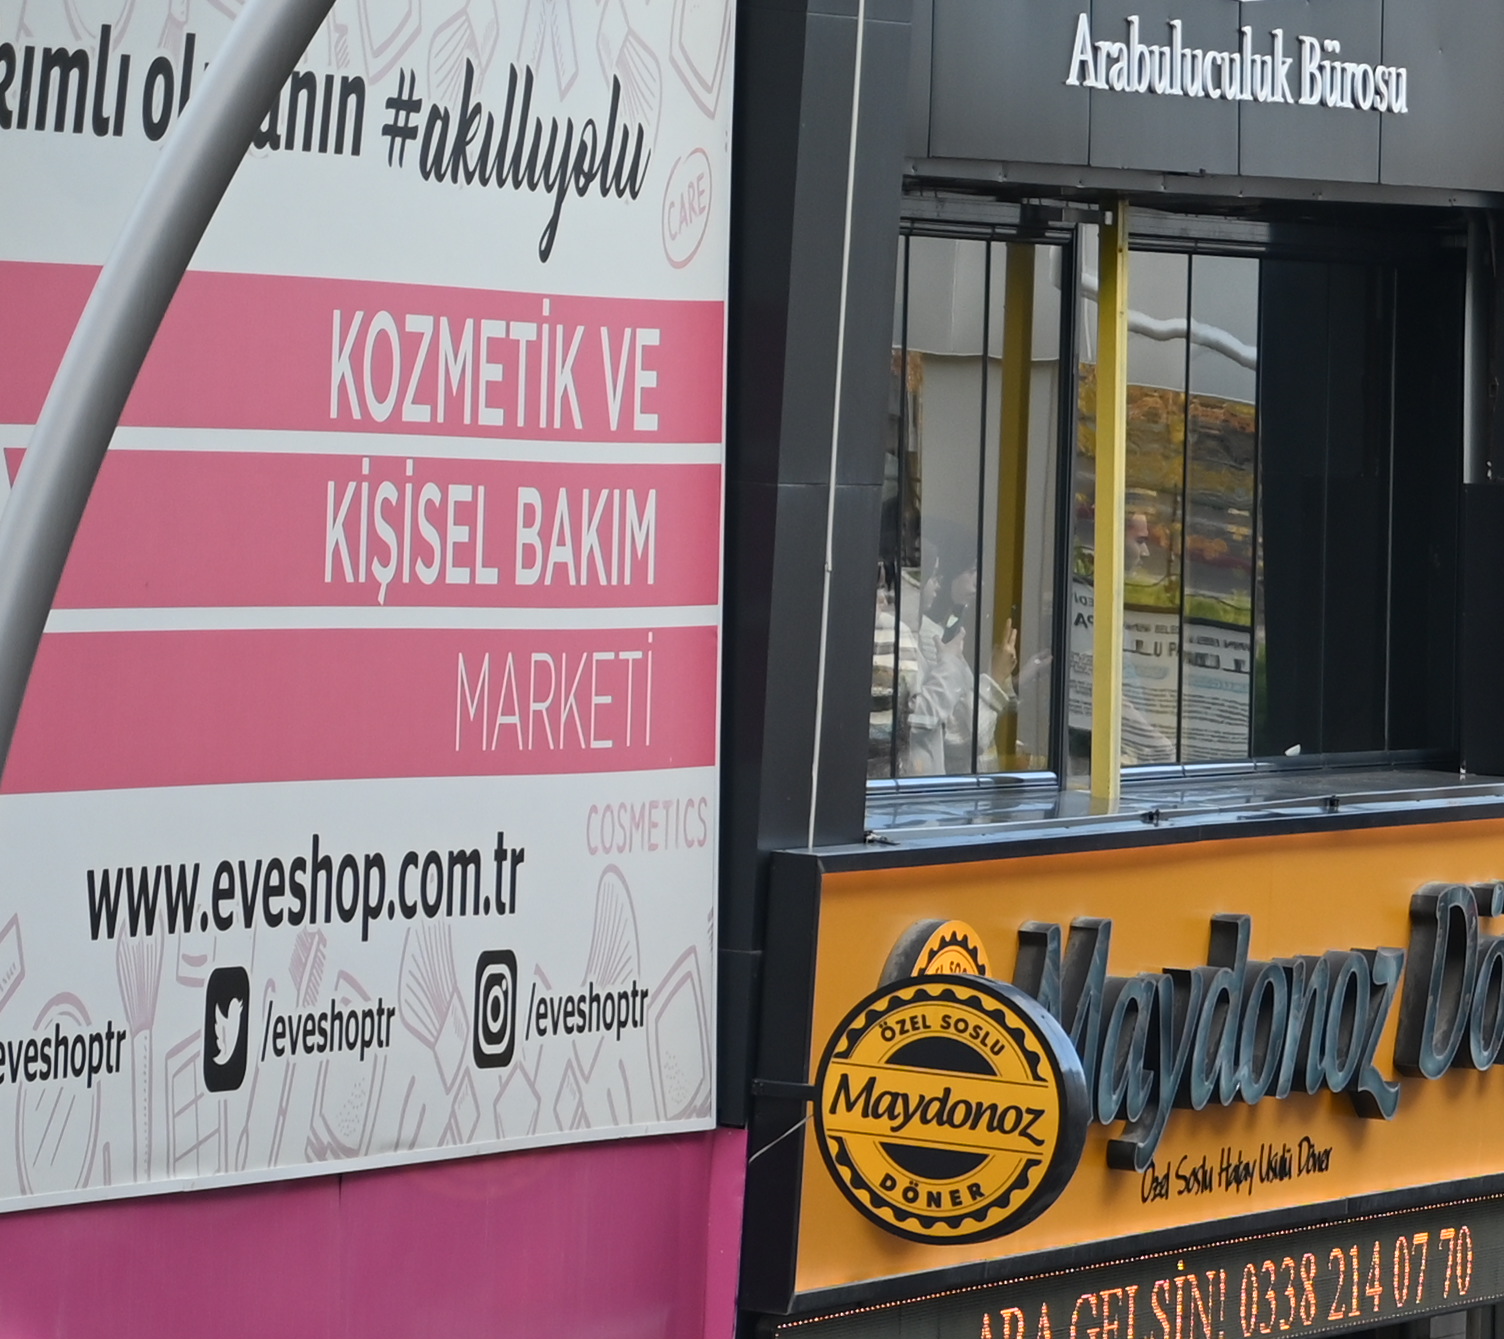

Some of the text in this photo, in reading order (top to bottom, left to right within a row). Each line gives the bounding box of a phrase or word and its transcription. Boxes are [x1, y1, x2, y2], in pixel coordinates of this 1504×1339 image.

[1065, 12, 1409, 114] Arabuluculuk Bürosu
[666, 174, 708, 243] CARE
[330, 298, 661, 433] KOZMETİK VE
[324, 457, 657, 606] KİŞİSEL BAKIM
[455, 632, 655, 752] MARKETİ
[586, 797, 709, 855] COSMETICS
[86, 830, 526, 942] www.eveshop.com.tr
[879, 1014, 1006, 1057] ÖZEL SOSLU
[1014, 914, 1403, 1171] Maydonoz
[829, 1073, 1045, 1147] Maydonoz
[878, 1172, 986, 1209] DÖNER
[1177, 1154, 1213, 1196] Soslu
[1240, 1251, 1319, 1339] 0338
[1328, 1244, 1382, 1321] 214
[1393, 1231, 1430, 1310] 07
[1440, 1225, 1475, 1300] 70
